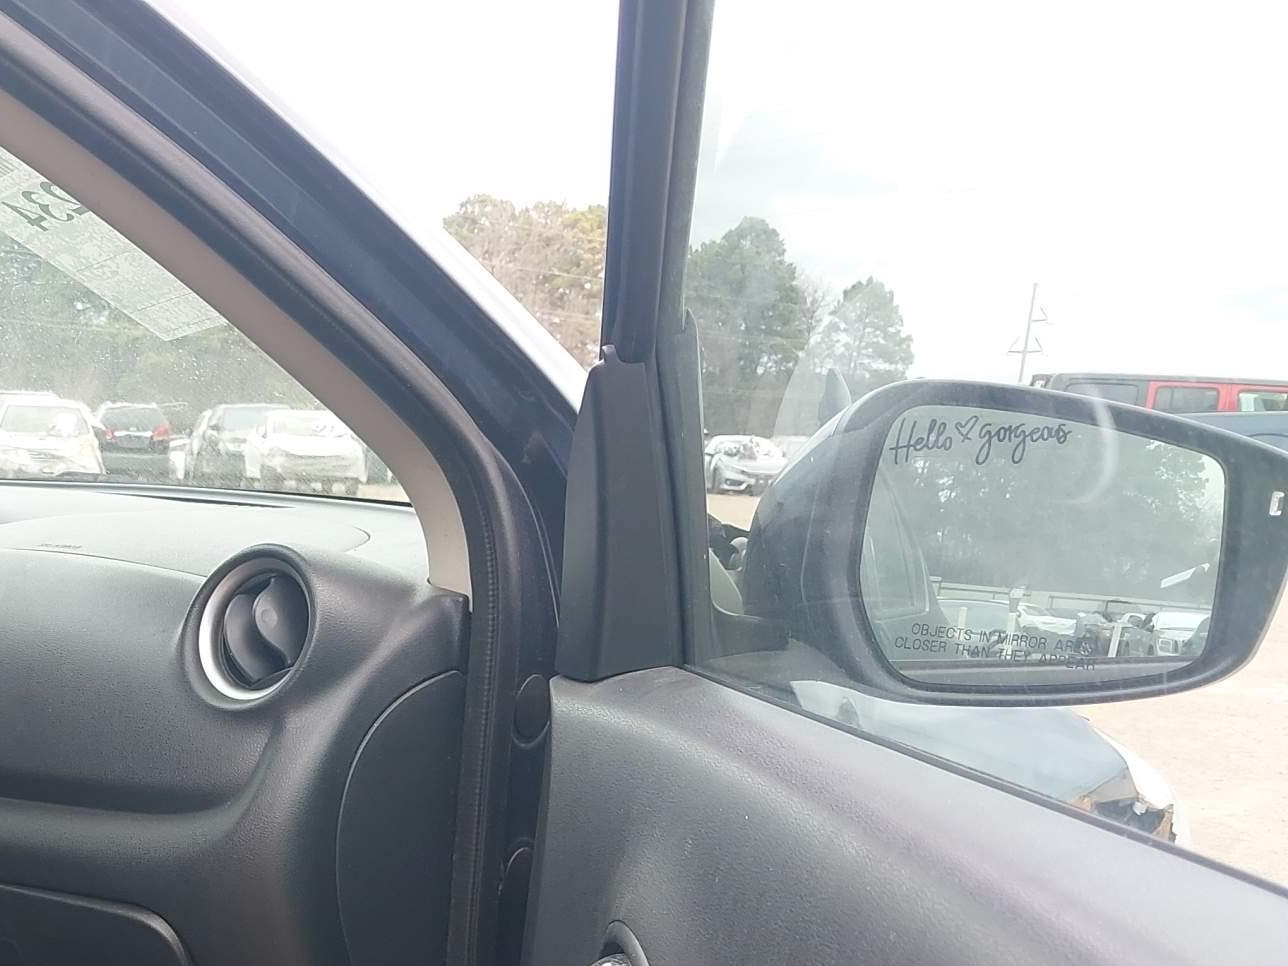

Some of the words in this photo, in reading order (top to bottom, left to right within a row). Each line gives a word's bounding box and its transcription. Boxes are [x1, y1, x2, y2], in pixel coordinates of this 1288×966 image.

[889, 418, 953, 464] Hello
[975, 422, 1073, 466] gorgeous
[894, 636, 947, 653] CLOSER
[954, 642, 990, 659] THAN
[998, 648, 1032, 663] THEY
[911, 622, 973, 641] OBJECTS
[979, 630, 992, 643] IN
[996, 632, 1048, 649] MIRROR
[1055, 639, 1083, 654] AR
